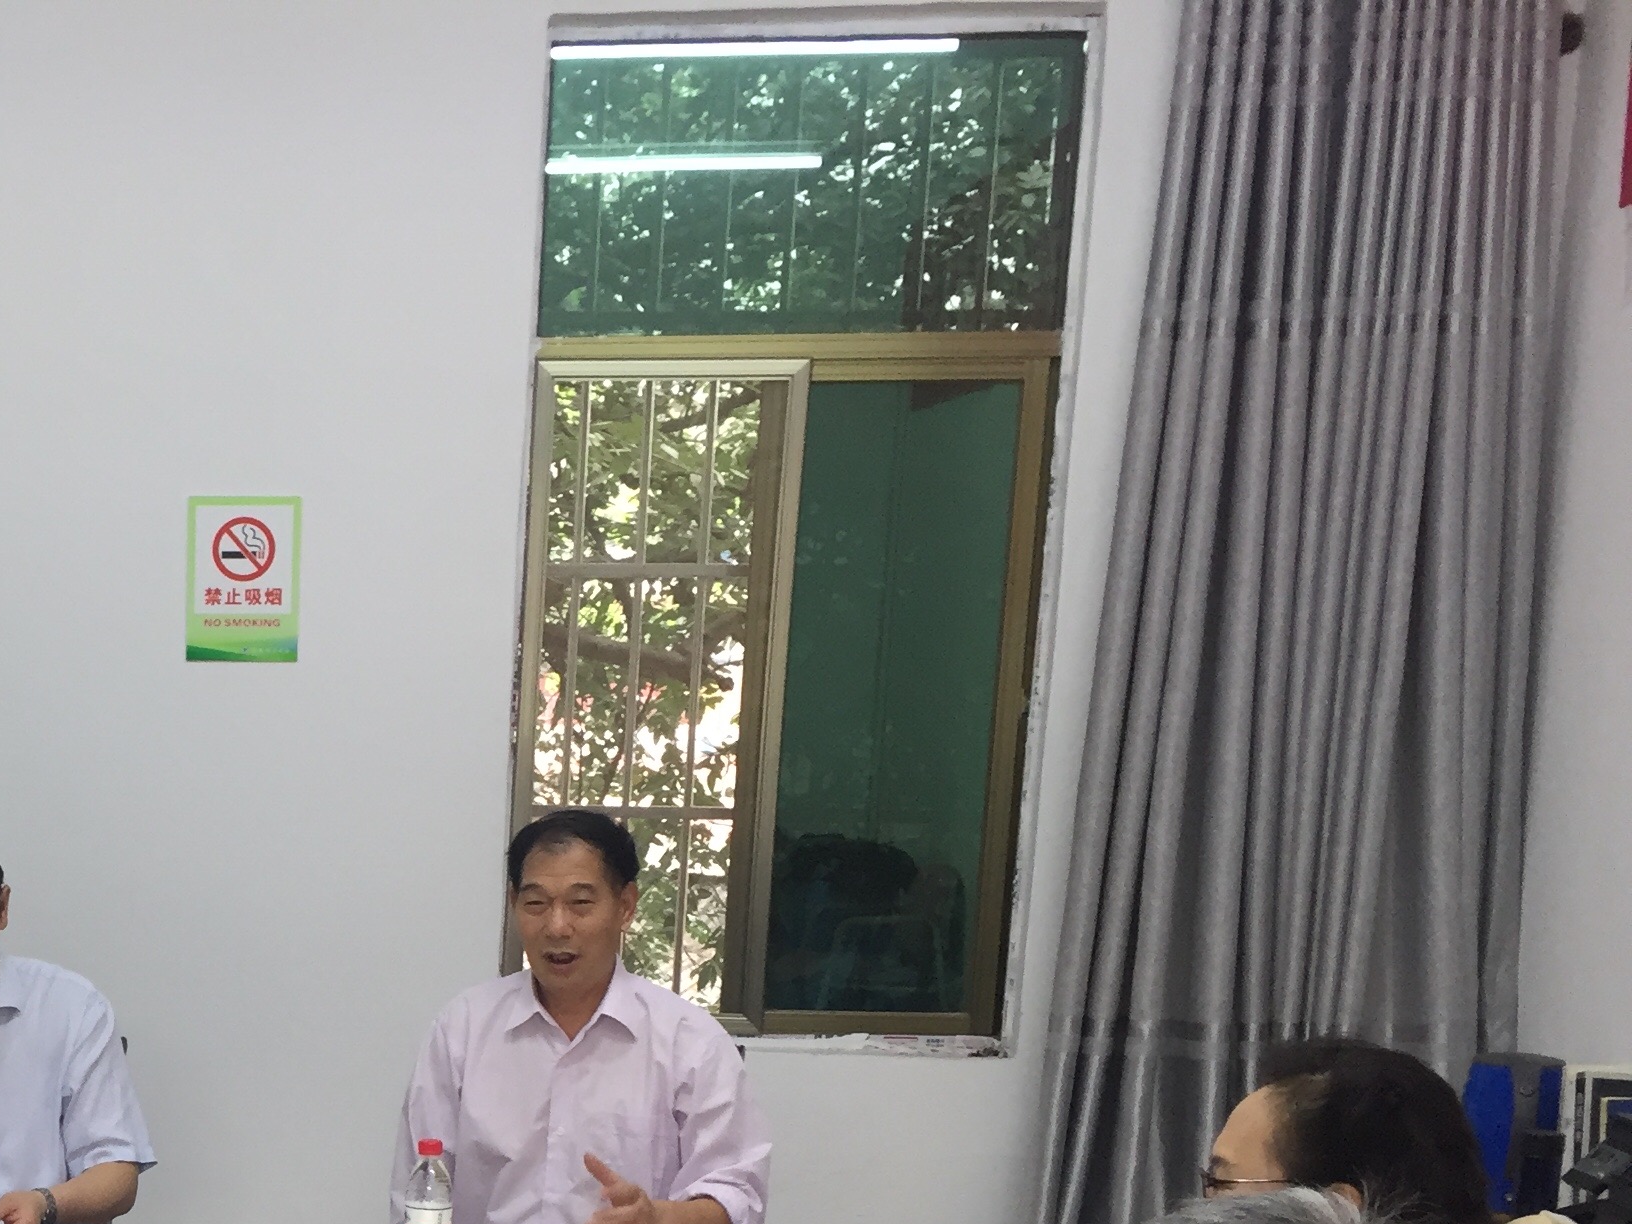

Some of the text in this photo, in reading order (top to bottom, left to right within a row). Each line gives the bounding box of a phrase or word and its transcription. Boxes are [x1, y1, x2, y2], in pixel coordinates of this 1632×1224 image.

[204, 588, 282, 606] 禁止吸烟
[204, 618, 281, 627] NO SMOKING
